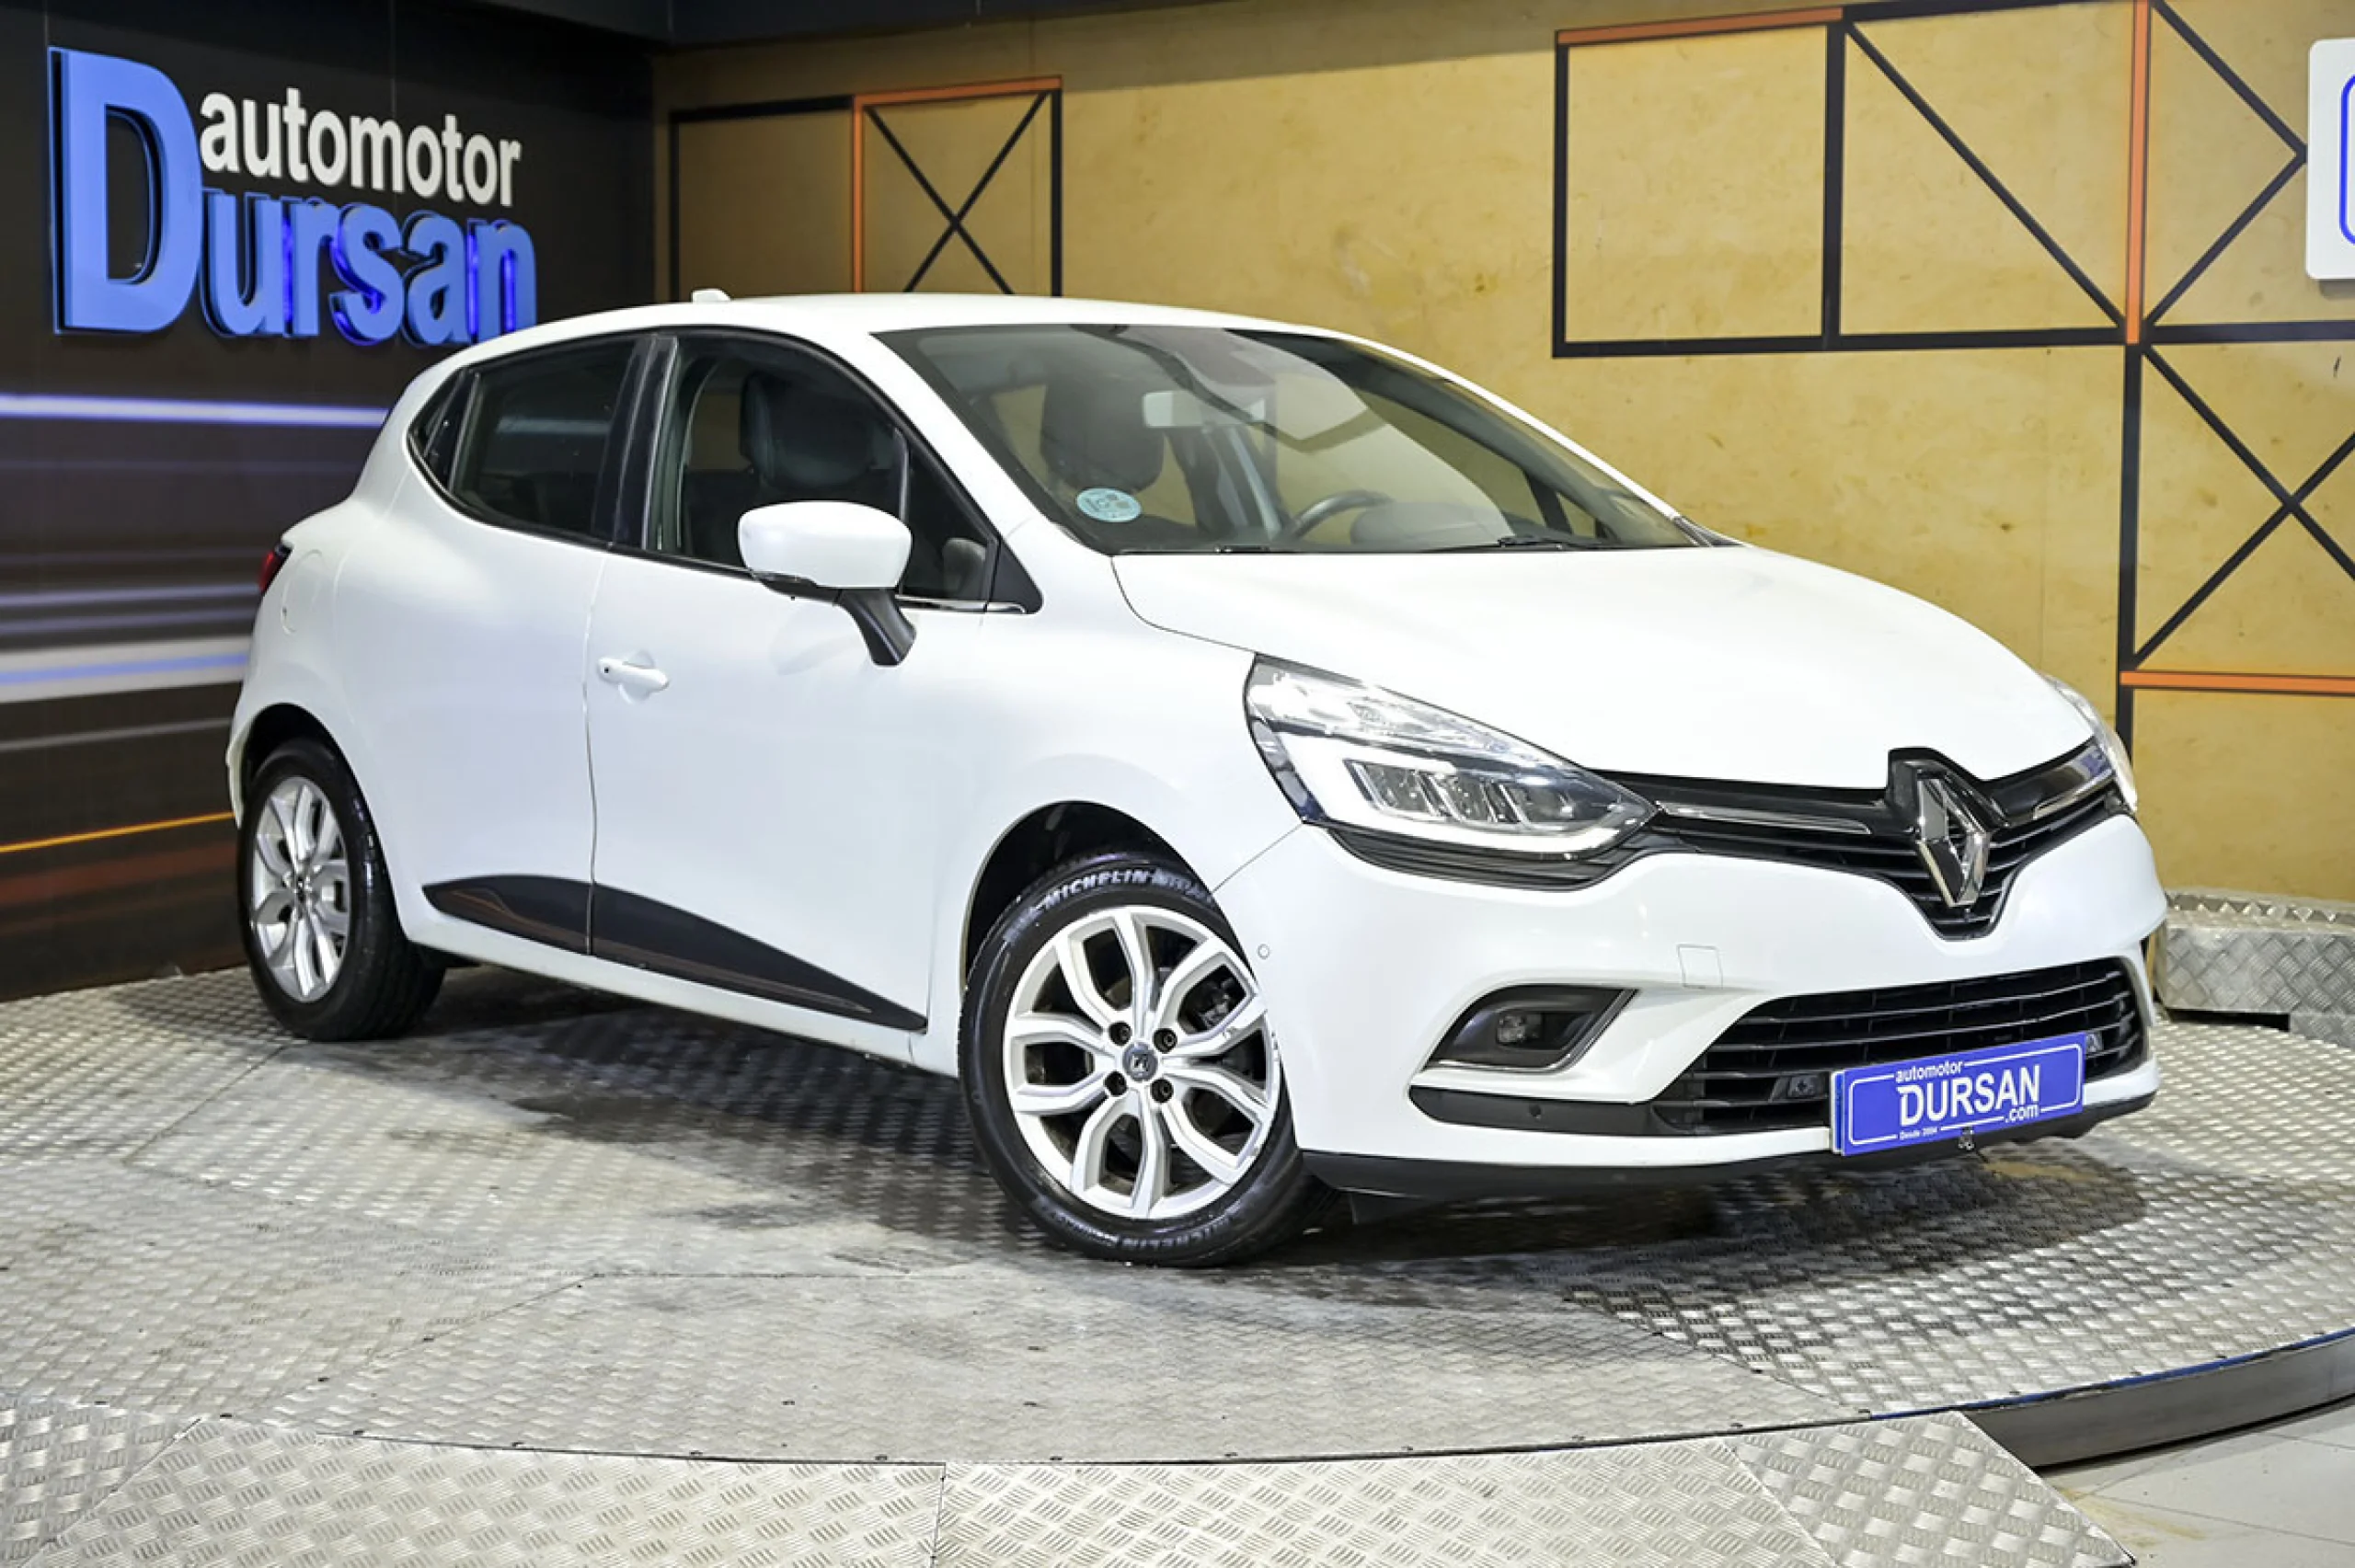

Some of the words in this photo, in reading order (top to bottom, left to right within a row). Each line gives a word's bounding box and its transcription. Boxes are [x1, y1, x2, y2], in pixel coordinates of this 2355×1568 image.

[199, 87, 522, 207] automotor
[48, 46, 537, 347] Dursan
[1896, 1060, 1963, 1083] automotor
[1897, 1065, 2040, 1127] DURSAN
[2005, 1104, 2039, 1123] .com
